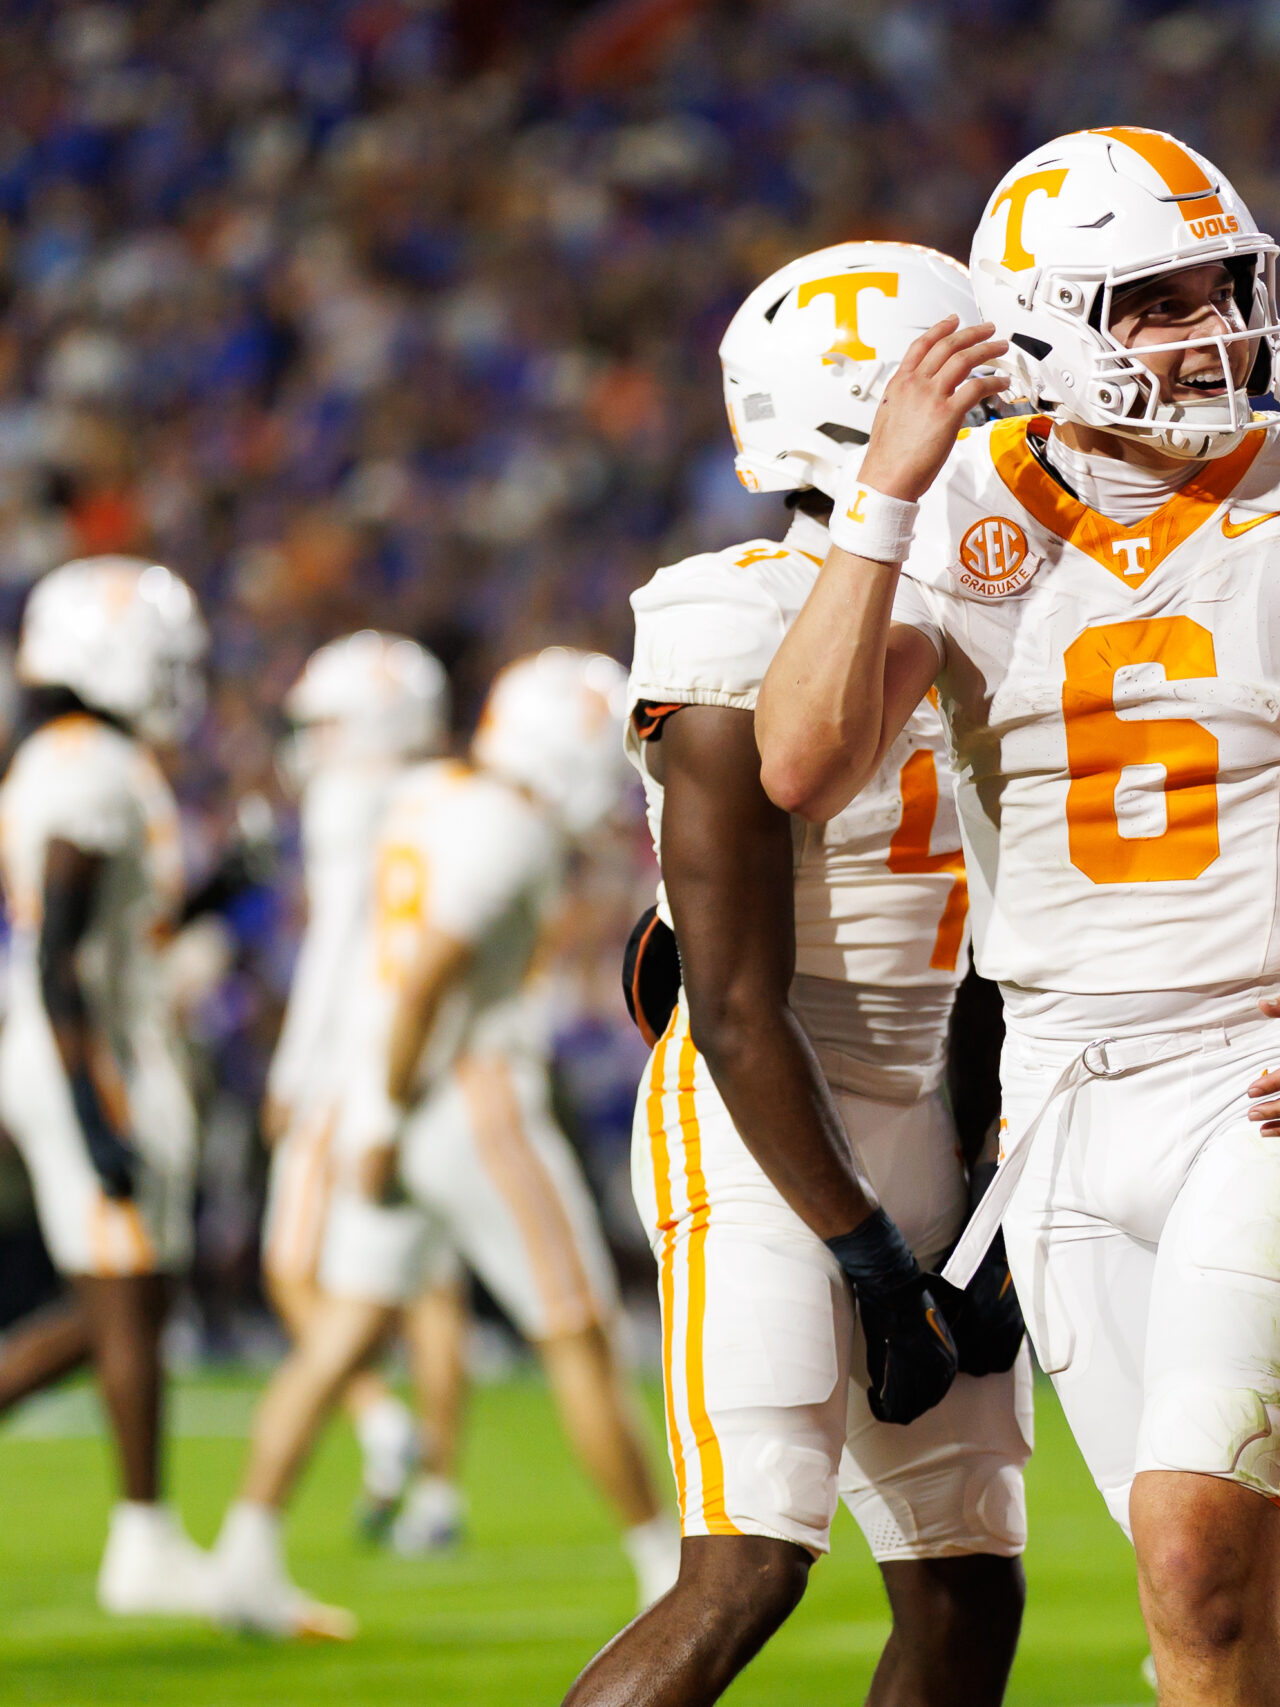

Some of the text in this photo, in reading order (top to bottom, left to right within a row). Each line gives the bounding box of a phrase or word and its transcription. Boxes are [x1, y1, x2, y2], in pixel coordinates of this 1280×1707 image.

[991, 168, 1070, 273] T
[1189, 215, 1239, 240] VOLS
[797, 271, 899, 366] T
[960, 568, 1031, 595] GRADUATE
[965, 521, 1020, 576] SEC
[1111, 537, 1151, 576] T
[1061, 614, 1222, 885] 6
[885, 748, 970, 972] 4
